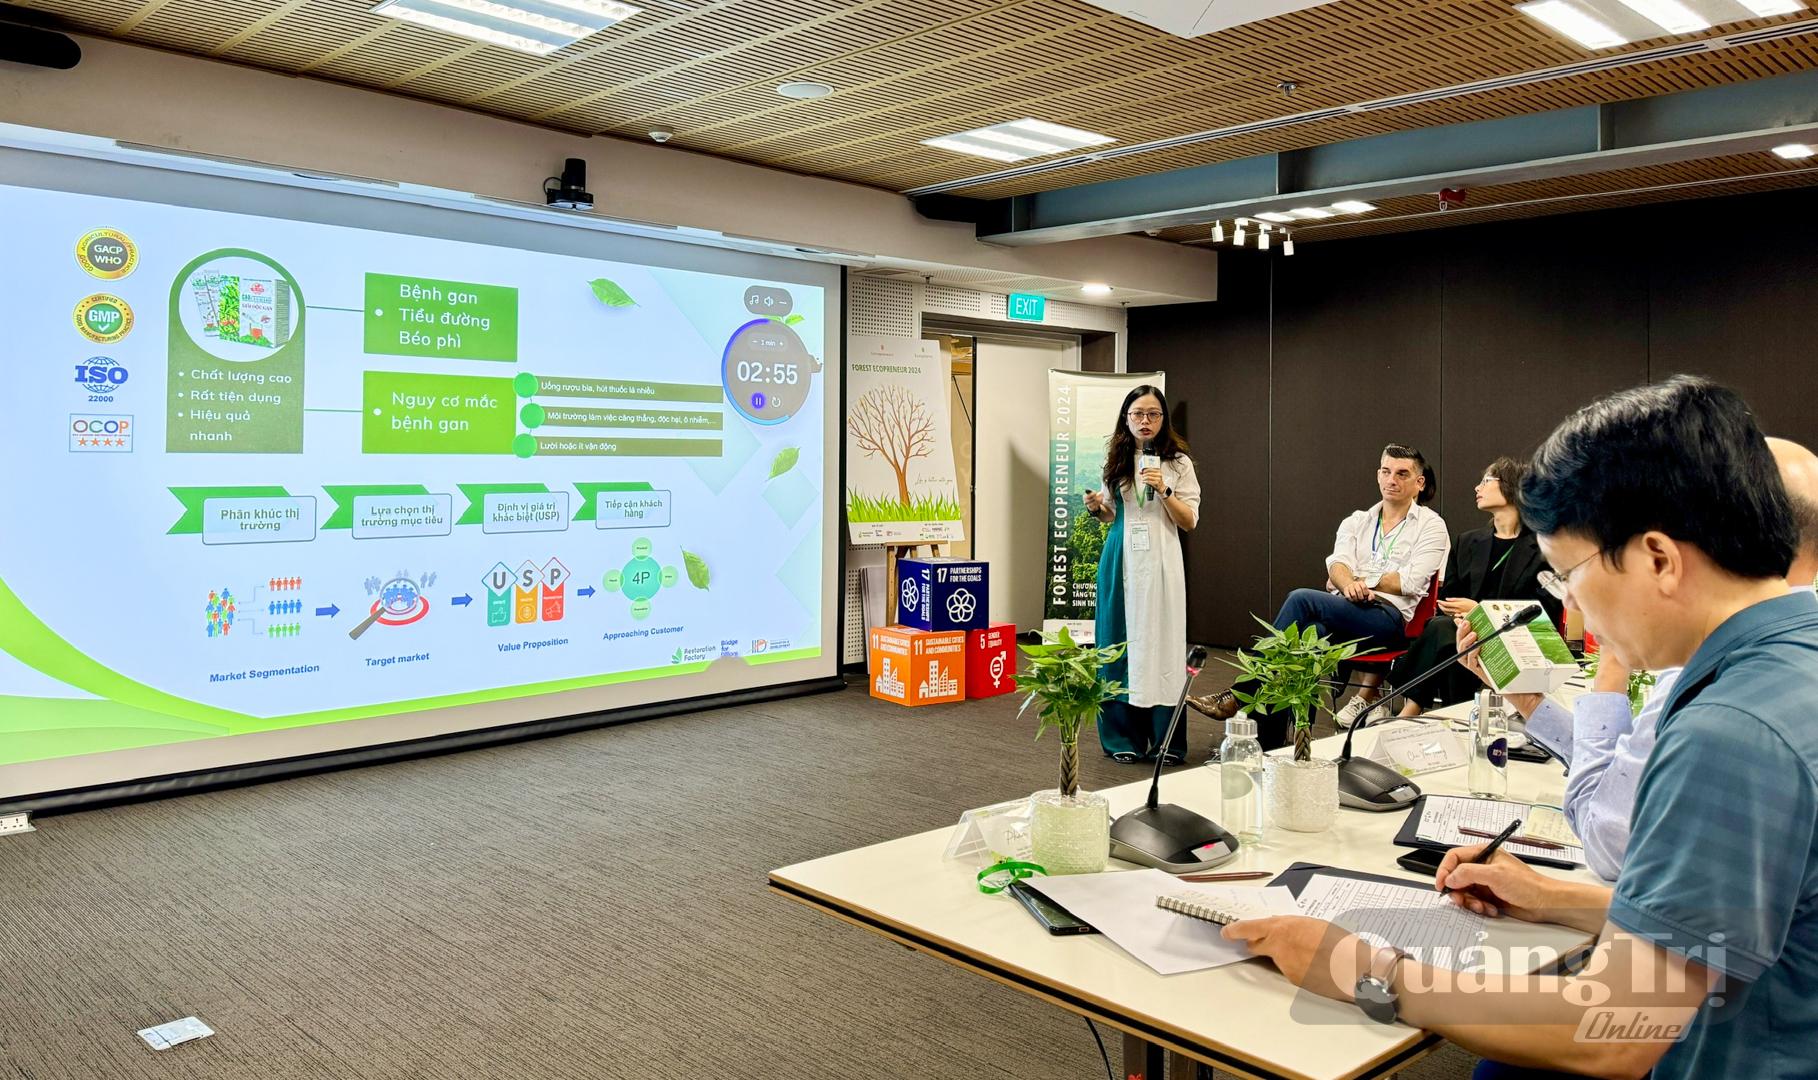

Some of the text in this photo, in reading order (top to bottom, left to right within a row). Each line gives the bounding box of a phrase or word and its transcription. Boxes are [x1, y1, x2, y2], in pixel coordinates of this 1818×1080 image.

[94, 244, 123, 254] GACP
[94, 255, 122, 265] WHO
[400, 284, 478, 306] Bệnh gan
[1016, 297, 1038, 316] EXIT
[88, 309, 120, 323] GMP
[399, 308, 490, 330] Tiểu đường
[399, 330, 461, 350] Béo phì
[75, 365, 129, 384] ISO
[737, 361, 798, 385] 02:55
[852, 363, 921, 374] FOREST ECOPRENEUR 2024
[191, 369, 292, 384] Chất lượng cao
[541, 381, 560, 392] Uống
[562, 384, 580, 392] rượu
[596, 384, 608, 392] hút
[191, 389, 281, 405] Rất tiện dụng
[392, 392, 498, 409] Nguy cơ mắc
[190, 409, 251, 422] Hiệu quả
[73, 420, 129, 433] OCOP
[391, 415, 469, 434] bệnh gan
[190, 431, 232, 441] nhanh
[600, 442, 616, 452] động
[1053, 384, 1071, 606] FOREST ECOPRENEUR 2024
[371, 505, 434, 516] Lựa chọn thị
[497, 502, 556, 512] Định vị giá trị
[605, 499, 662, 509] Tiếp cận khách
[221, 508, 299, 520] Phân khúc thị
[492, 511, 560, 522] khác biệt (USP)
[624, 509, 643, 518] hàng
[240, 521, 281, 531] trường
[361, 516, 443, 527] trường mục tiêu
[921, 568, 930, 580] 17
[937, 567, 948, 583] 17
[949, 566, 982, 574] PARTNERSHIPS
[632, 571, 651, 585] 4P
[1072, 582, 1097, 590] CHƯƠNG
[1072, 590, 1088, 598] TĂNG
[1072, 599, 1087, 607] SINH
[602, 625, 684, 641] Approaching Customer
[497, 637, 569, 652] Value Proposition
[872, 633, 879, 649] 11
[914, 639, 923, 655] 11
[980, 634, 986, 650] 5
[684, 645, 716, 654] Restoration
[365, 653, 430, 668] Target market
[209, 663, 320, 682] Market Segmentation
